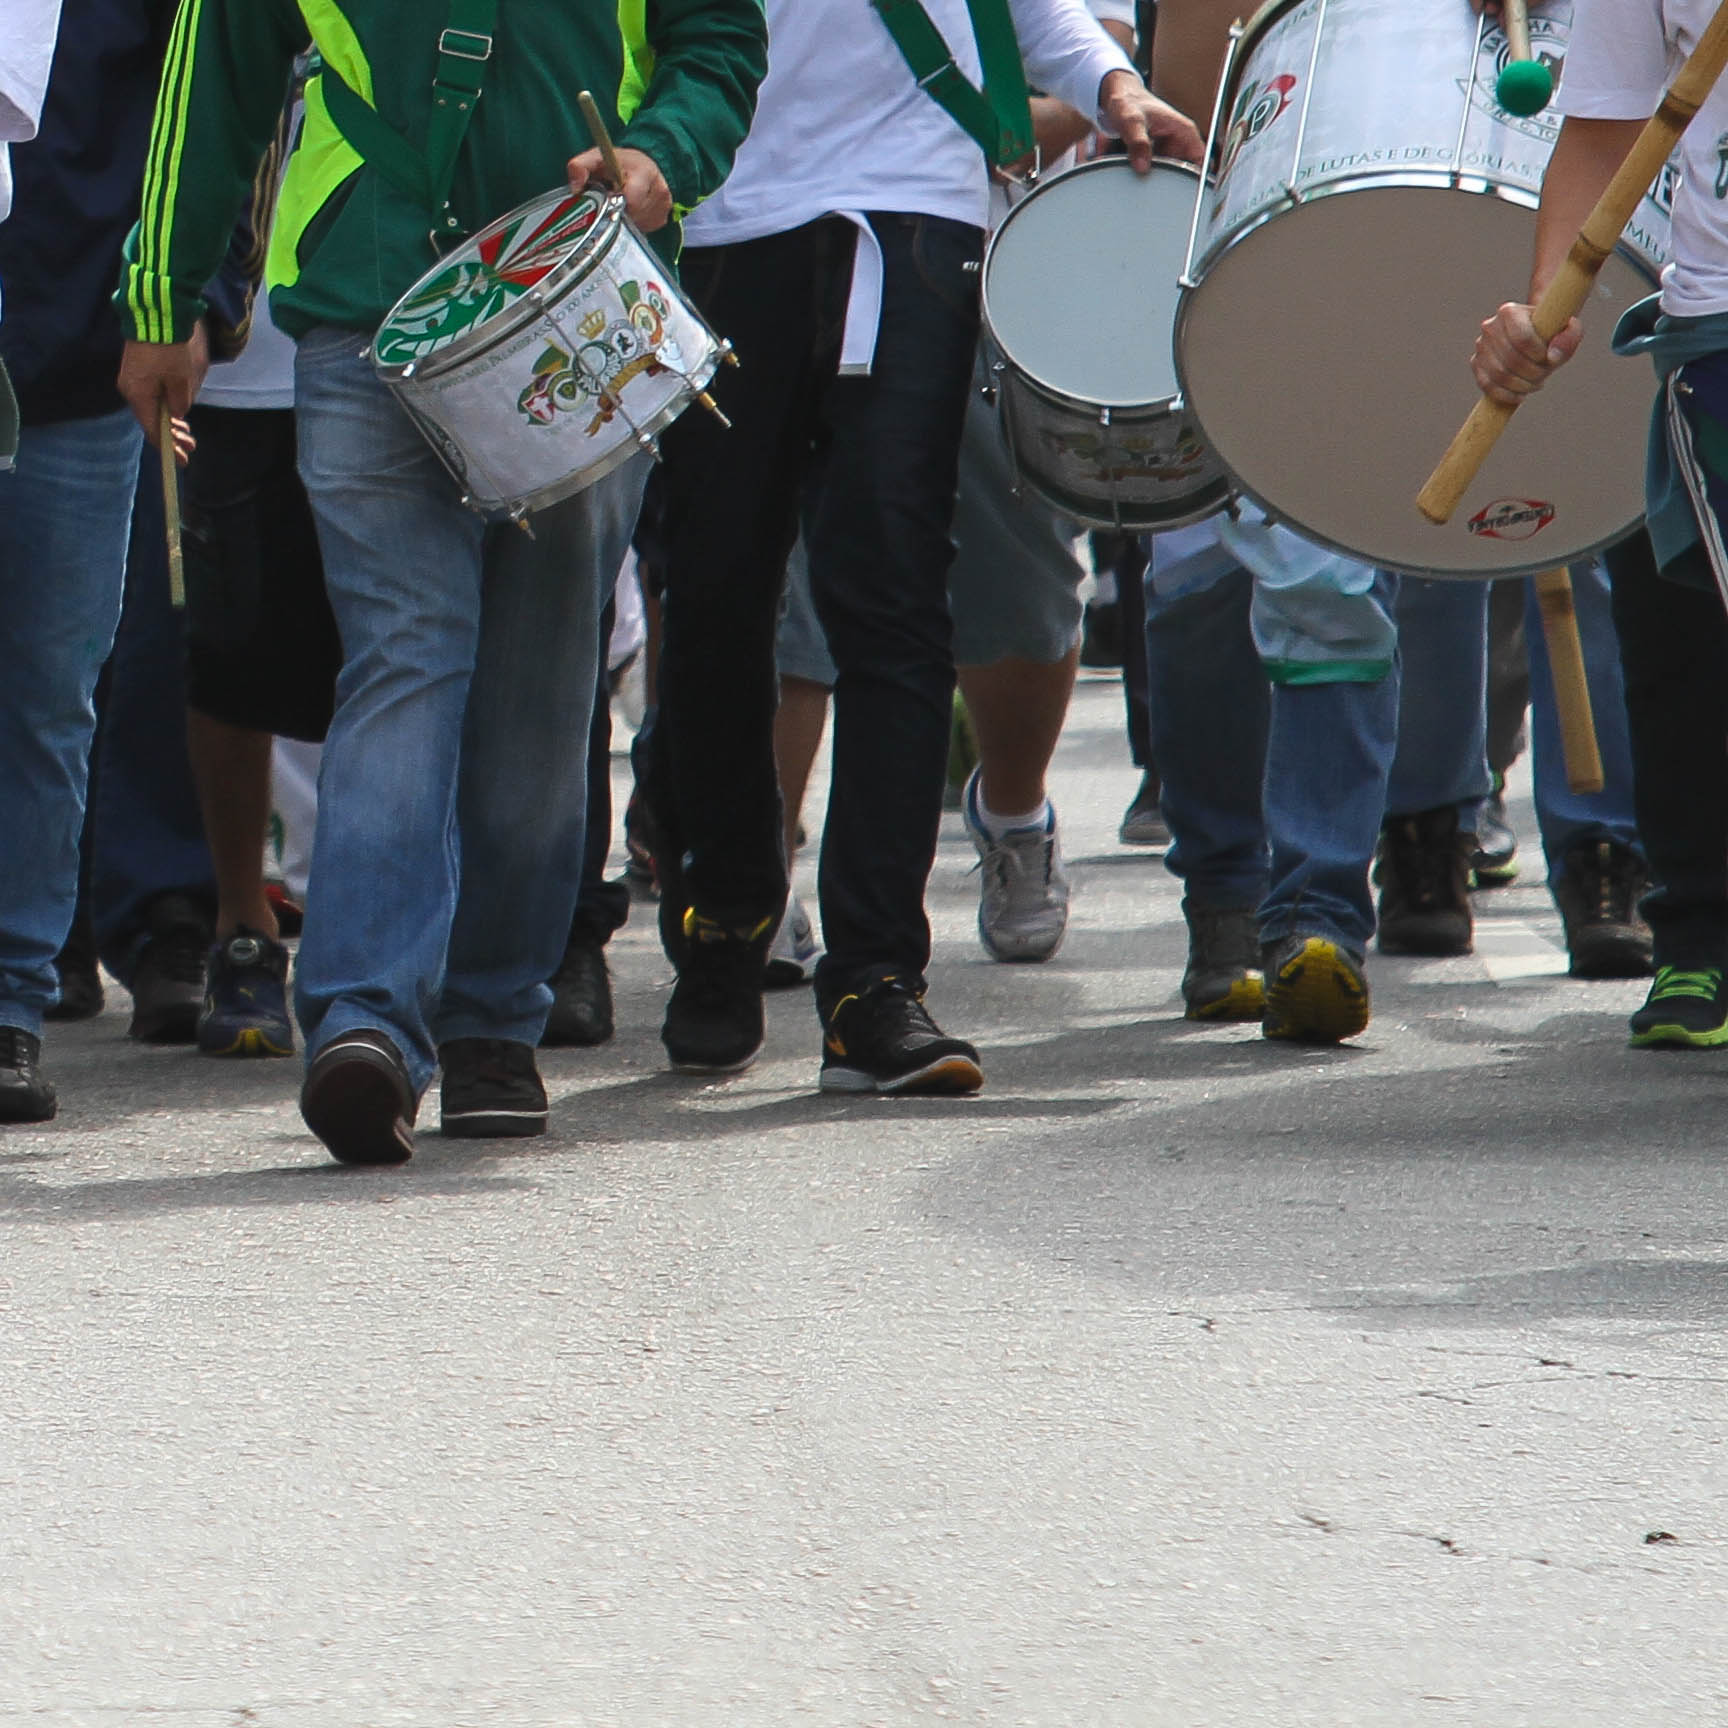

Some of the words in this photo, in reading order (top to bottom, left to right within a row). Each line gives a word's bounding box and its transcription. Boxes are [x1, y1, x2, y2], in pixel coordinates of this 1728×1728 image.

[1320, 150, 1382, 173] LUTAS
[1402, 147, 1432, 160] DE
[1436, 147, 1534, 178] GÓRIAS,
